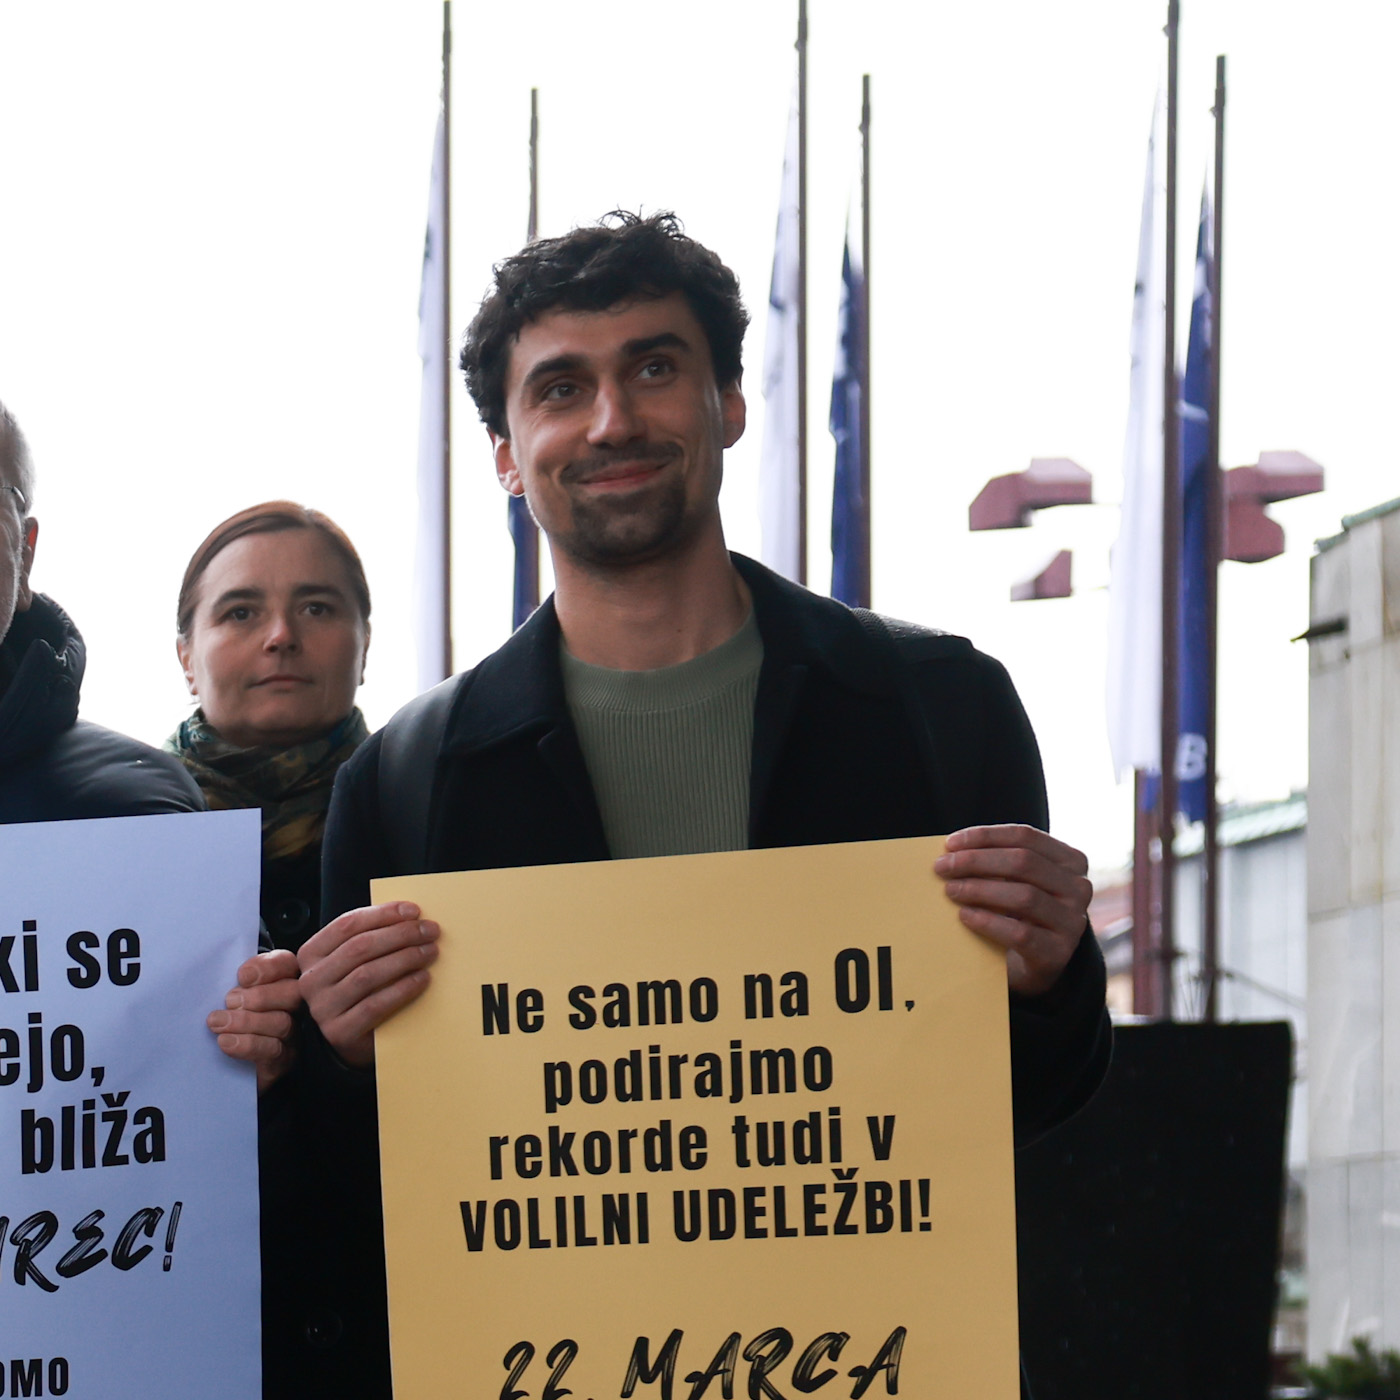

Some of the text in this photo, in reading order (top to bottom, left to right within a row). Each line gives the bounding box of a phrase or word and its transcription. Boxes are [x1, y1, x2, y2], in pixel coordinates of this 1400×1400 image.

[66, 929, 140, 989] se
[481, 946, 915, 1035] Ne samo na OI,
[544, 1040, 833, 1113] podirajmo
[21, 1091, 165, 1174] bliža
[489, 1107, 895, 1180] rekorde tudi v
[460, 1168, 931, 1252] VOLILNI UDELEŽBI!
